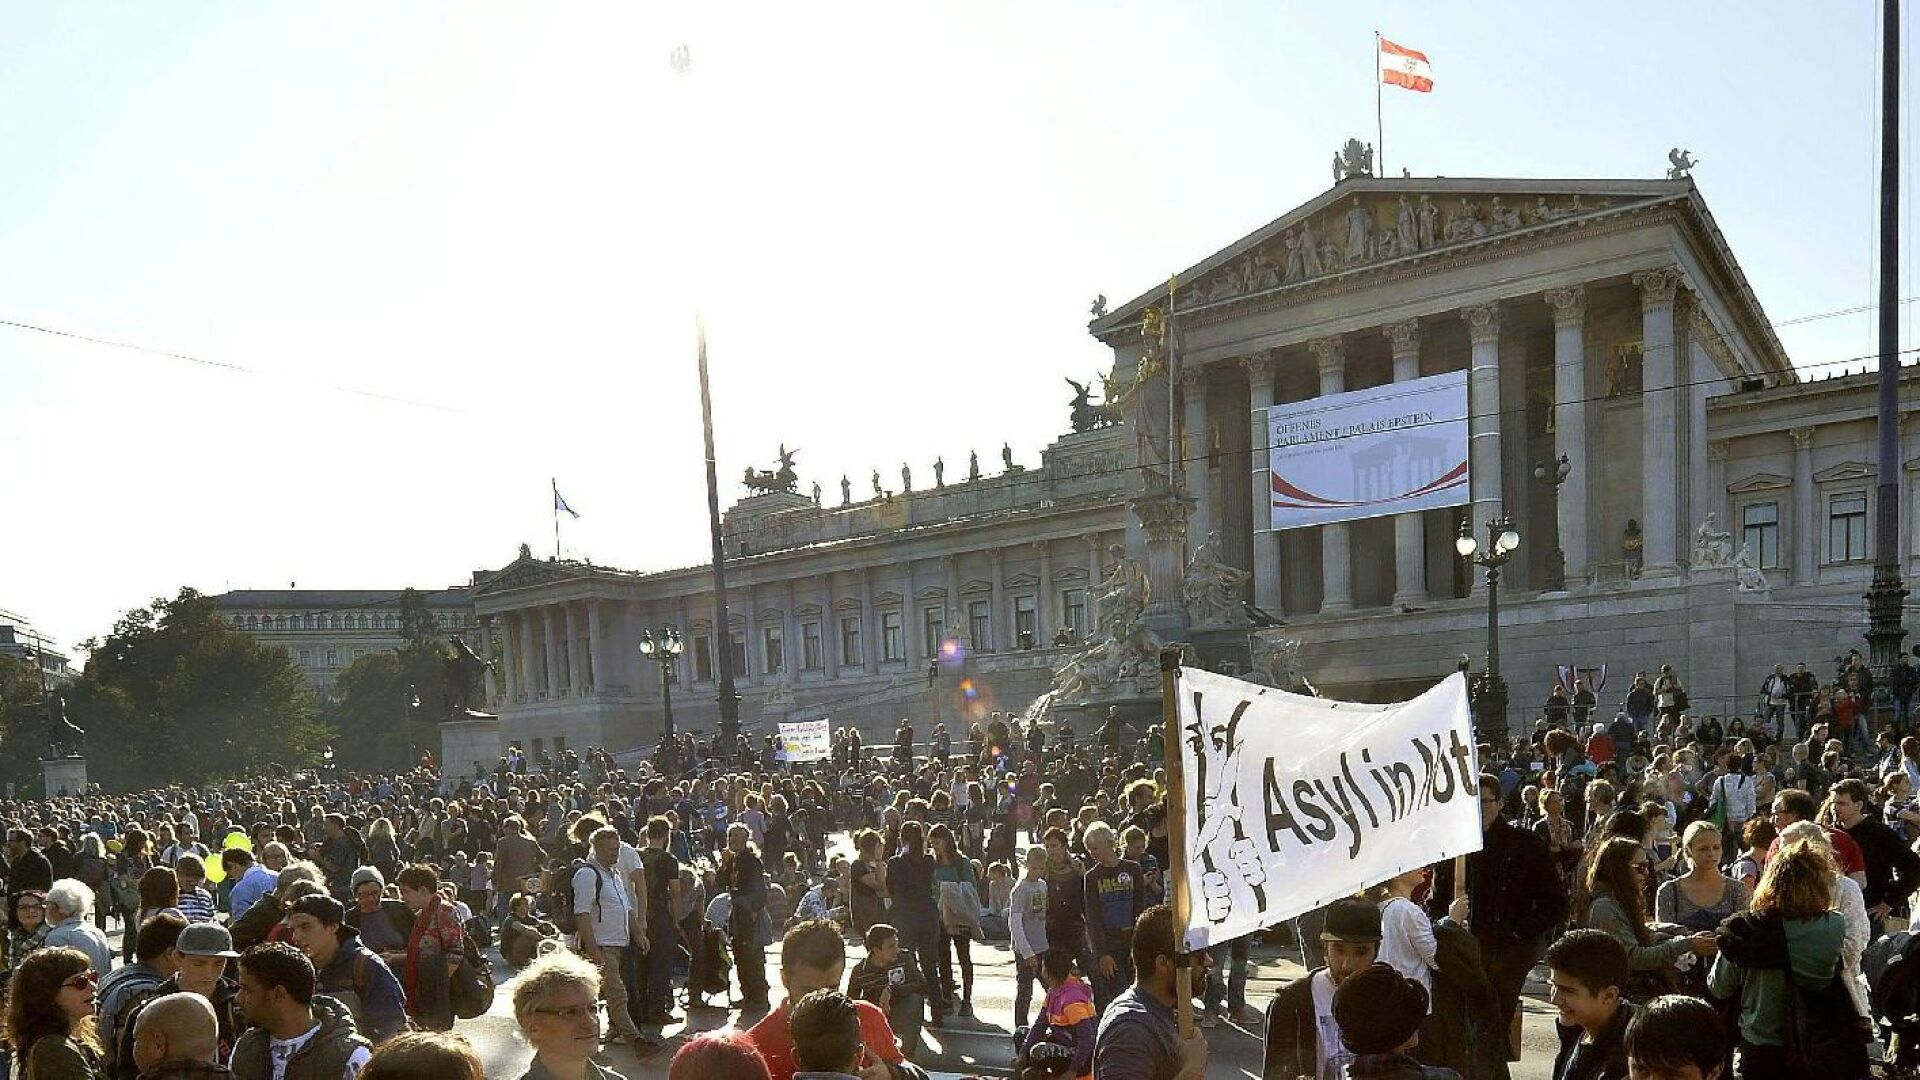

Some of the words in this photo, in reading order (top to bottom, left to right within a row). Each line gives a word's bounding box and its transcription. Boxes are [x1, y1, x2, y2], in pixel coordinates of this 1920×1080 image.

[1276, 419, 1321, 435] OFFENES
[1277, 428, 1340, 447] PARLAMENT
[1350, 419, 1385, 435] PALAIS
[1388, 411, 1433, 428] EPSTEIN
[1263, 751, 1379, 860] Asyl
[1362, 748, 1416, 822] in
[1411, 729, 1478, 810] Not
